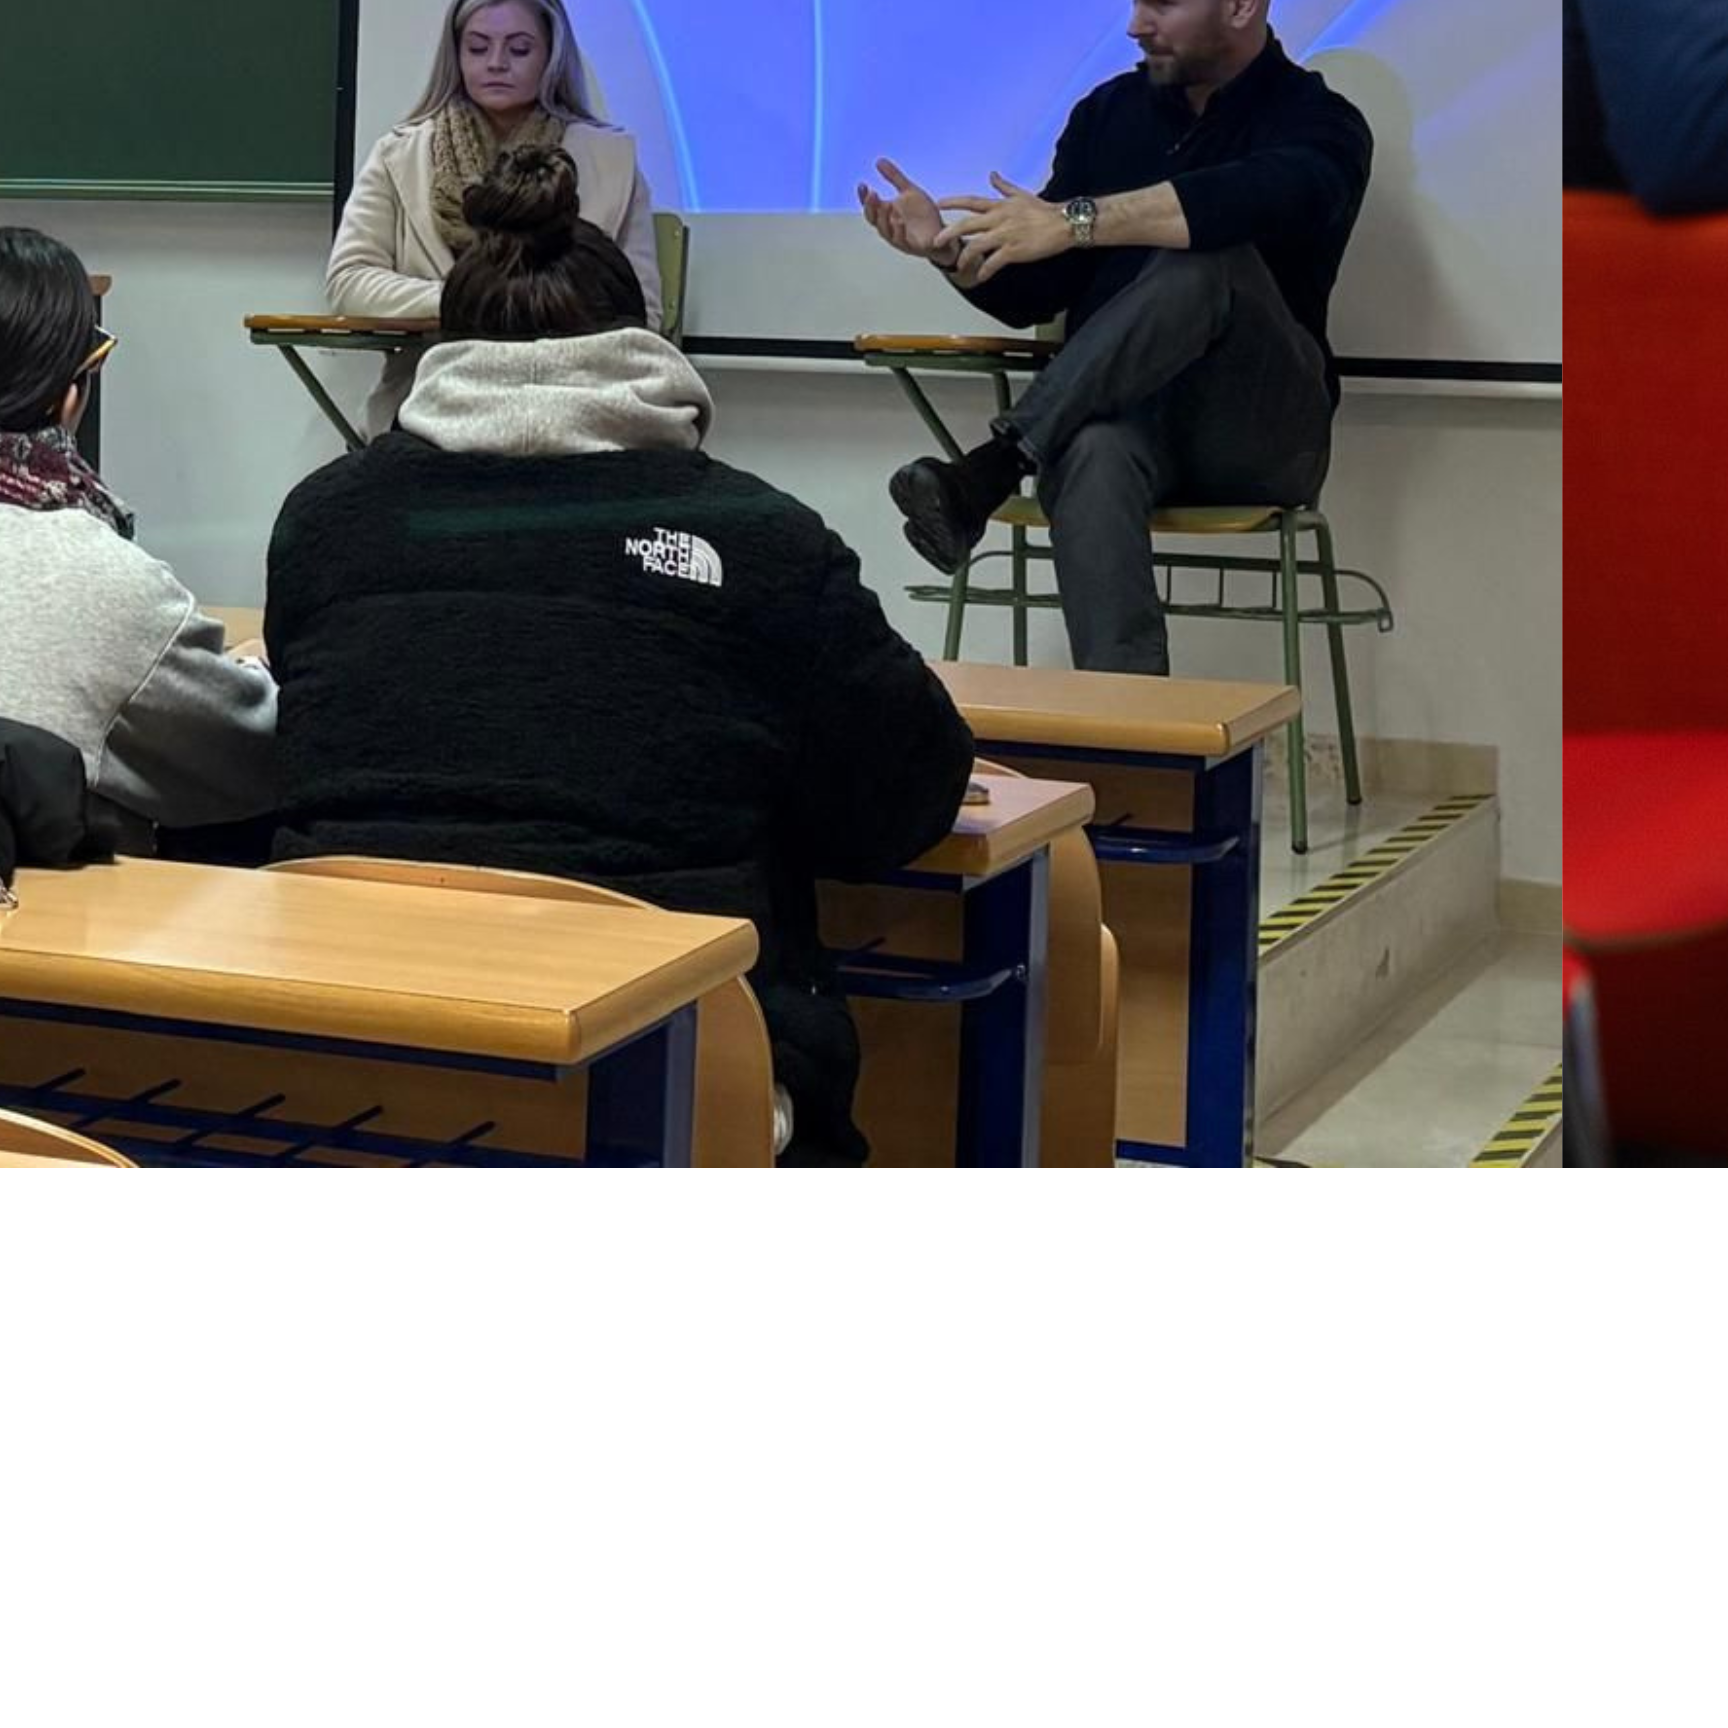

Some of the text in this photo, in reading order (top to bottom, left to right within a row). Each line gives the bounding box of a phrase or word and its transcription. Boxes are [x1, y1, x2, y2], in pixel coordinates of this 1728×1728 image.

[653, 526, 691, 548] THE
[625, 536, 691, 565] NORTH
[643, 554, 692, 579] FACE
